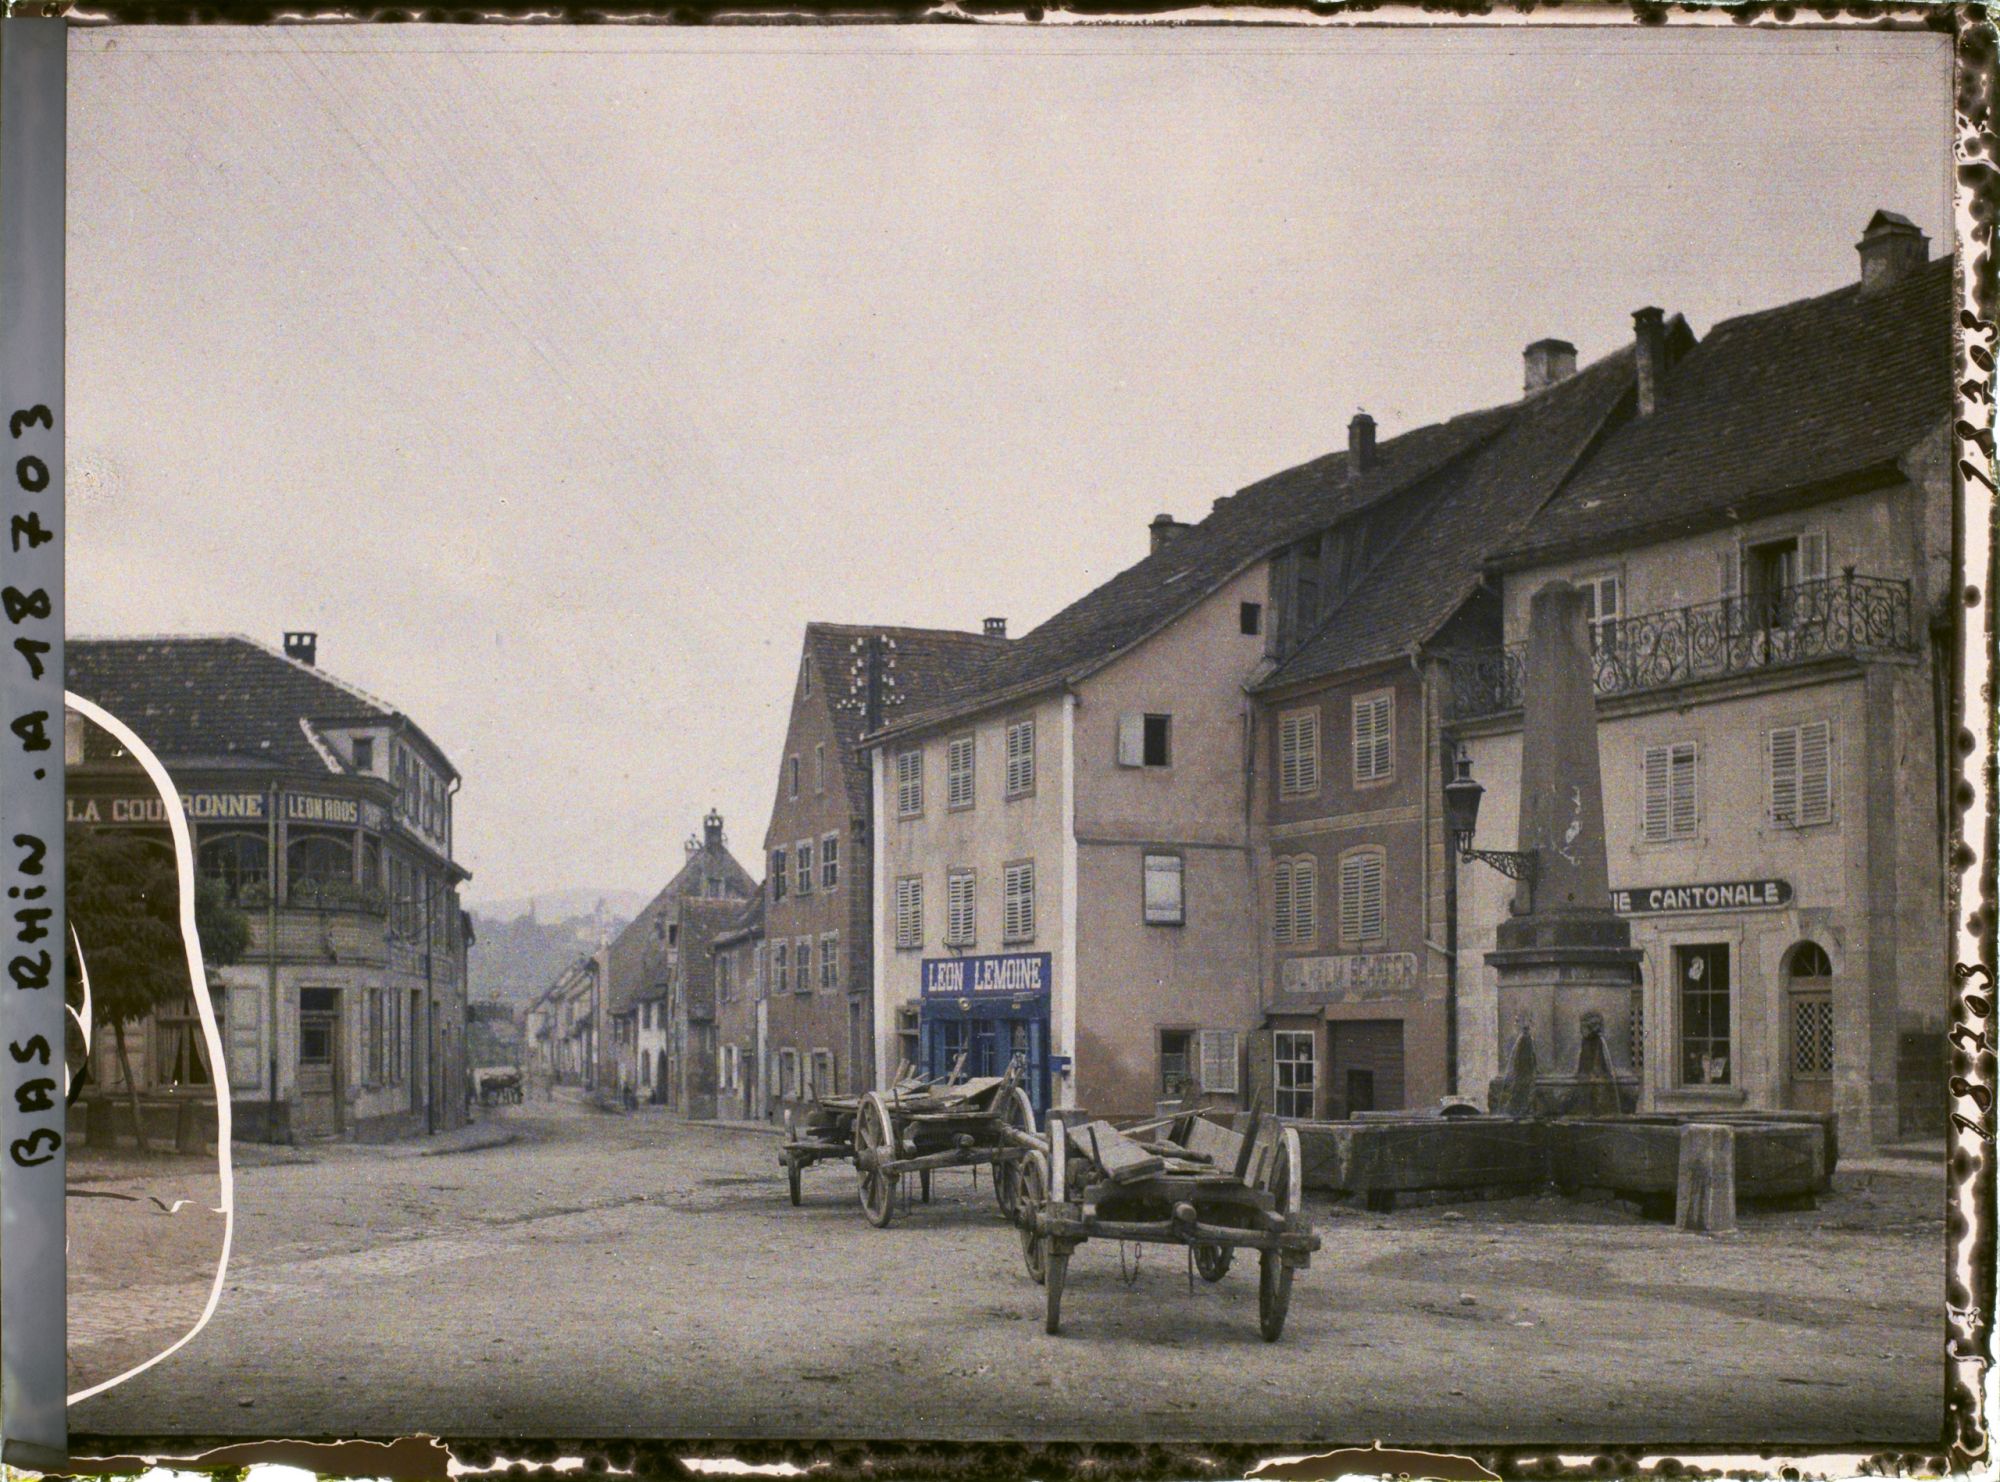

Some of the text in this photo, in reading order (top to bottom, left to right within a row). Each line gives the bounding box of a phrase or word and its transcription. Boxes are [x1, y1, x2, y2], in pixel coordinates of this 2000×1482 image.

[66, 799, 101, 822] LA
[289, 795, 322, 819] LEON
[1649, 882, 1780, 909] CANTONALE
[928, 957, 1042, 991] LEON LEMOINE
[10, 1034, 62, 1168] BAS
